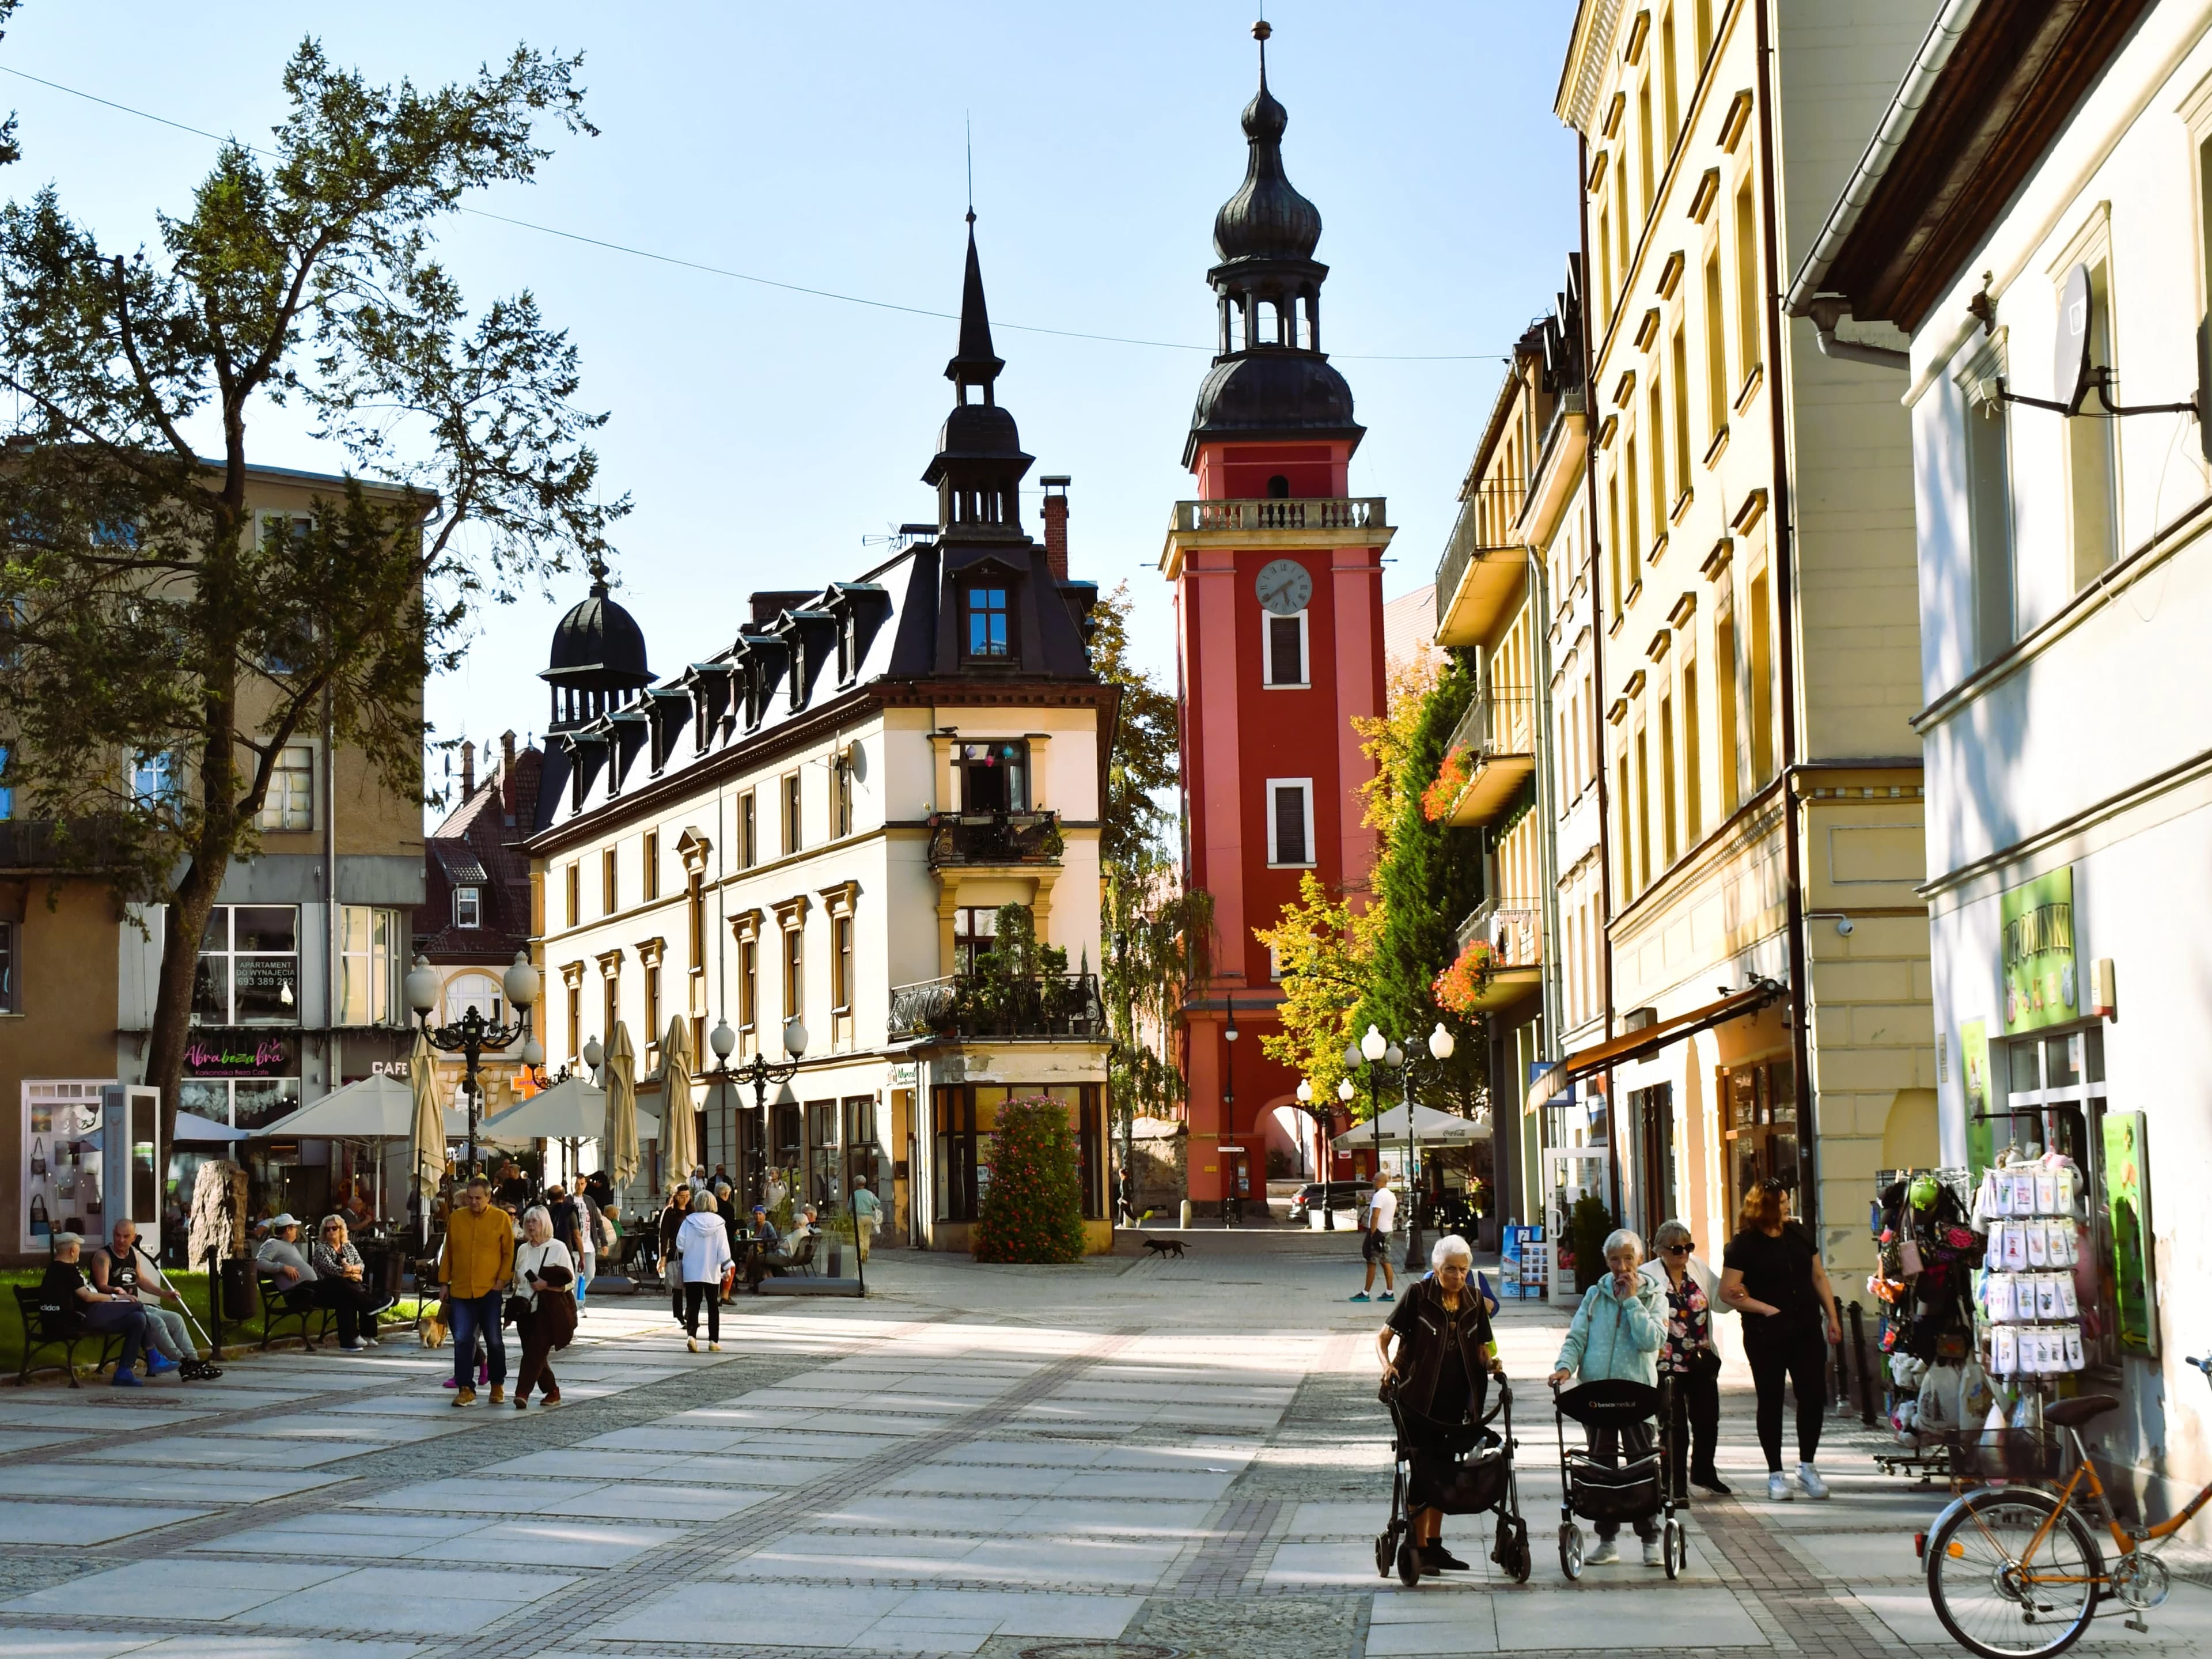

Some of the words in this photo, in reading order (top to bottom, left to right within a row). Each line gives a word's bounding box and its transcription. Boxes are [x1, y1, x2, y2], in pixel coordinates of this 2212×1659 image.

[2003, 902, 2070, 968] UPOMINKI
[237, 978, 255, 986] 693
[257, 978, 274, 986] 389
[276, 978, 294, 986] 292
[372, 1062, 407, 1075] CAFE
